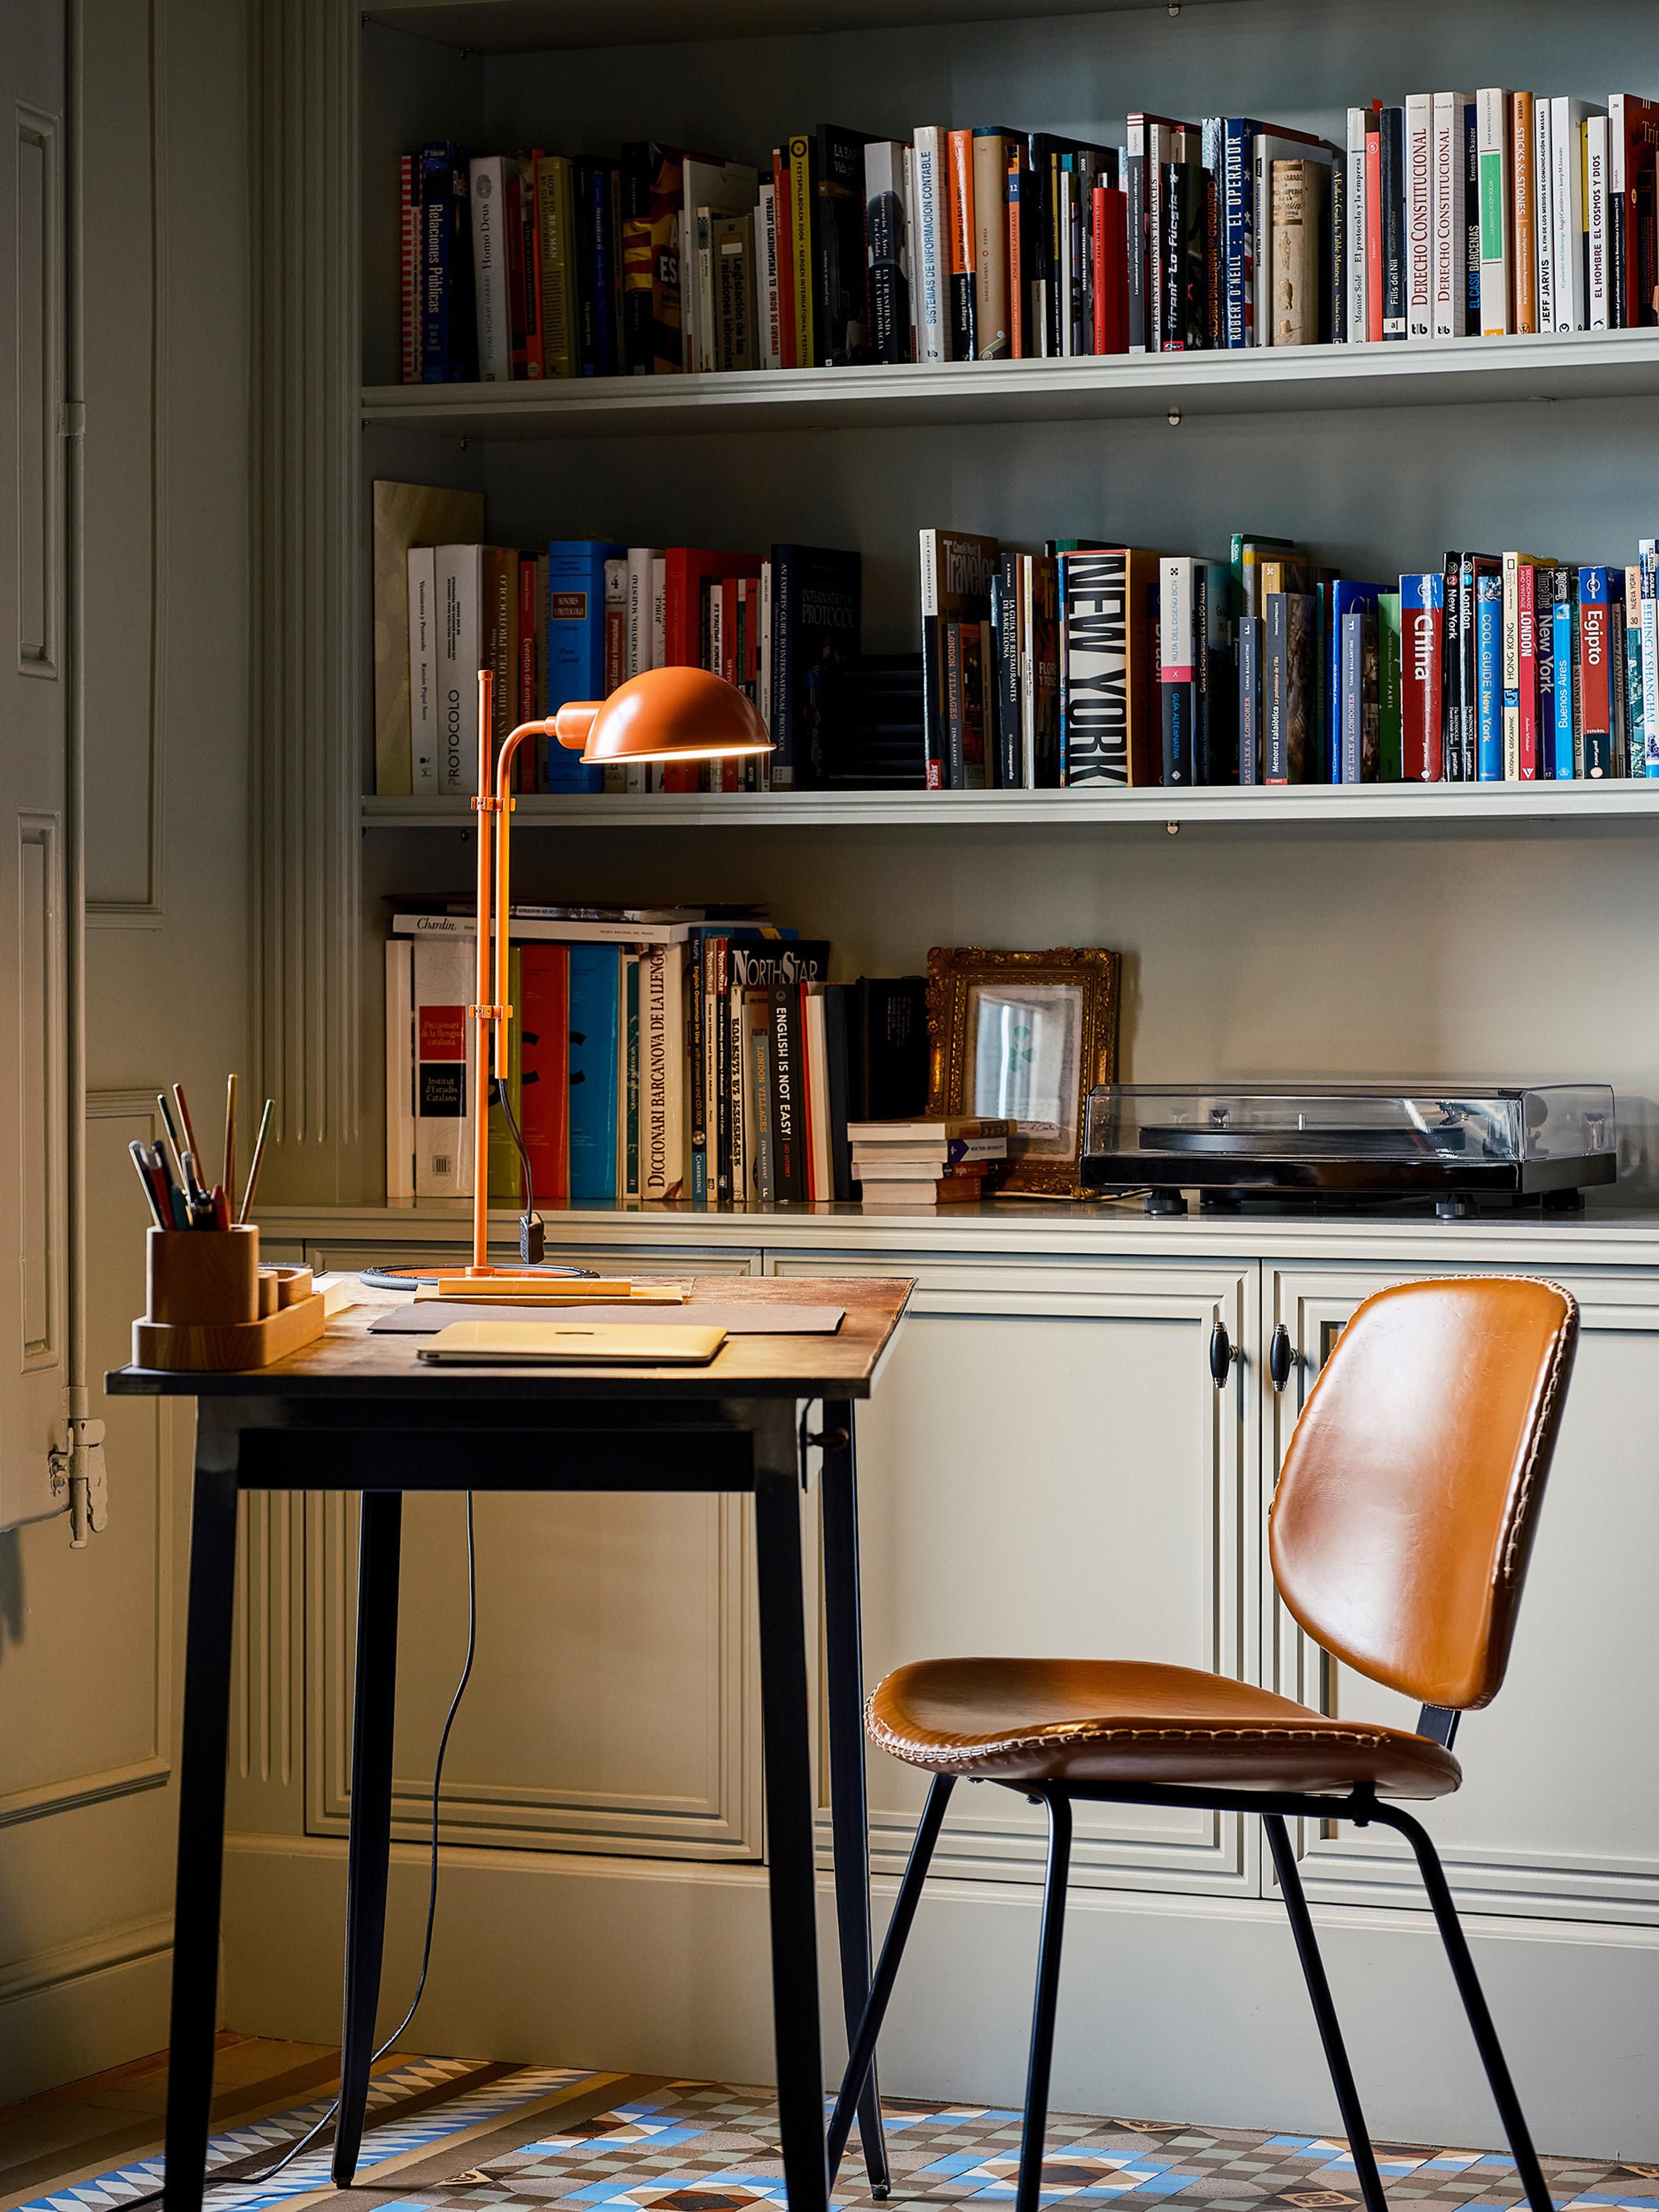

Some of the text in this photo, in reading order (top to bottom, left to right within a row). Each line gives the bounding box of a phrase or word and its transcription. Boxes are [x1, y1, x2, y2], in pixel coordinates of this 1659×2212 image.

[1516, 127, 1525, 161] STICKS
[1517, 163, 1525, 173] &
[1354, 194, 1361, 202] la
[1411, 128, 1427, 306] DERECHO CONSTITUCIONAL
[1437, 128, 1450, 301] DERECHO CONSTITUCIONAL
[1593, 189, 1601, 226] COSMOS
[481, 204, 491, 269] Homo Deus
[766, 196, 776, 286] EL PENSAMIENTO LATERAL
[921, 152, 936, 324] SISTEMAS DE INFORMACION CONTABLE
[1227, 137, 1241, 340] ROBERT O'NEILL EL OPERADOR
[1354, 211, 1363, 250] protocolo
[1594, 228, 1601, 239] EL
[428, 205, 444, 313] Relaciones Públicas
[1355, 253, 1361, 262] El
[1468, 226, 1480, 308] EL CASO BÁRCENAS
[1541, 259, 1550, 296] JARVIS
[1594, 244, 1602, 298] EL HOMBRE
[721, 259, 733, 369] relaciones laborales
[733, 258, 745, 354] Legislación de las
[1390, 287, 1399, 304] Fills
[771, 313, 777, 322] DE
[781, 563, 787, 575] AN
[1003, 600, 1009, 611] DE
[1009, 599, 1015, 609] LA
[780, 637, 786, 649] TO
[1010, 633, 1016, 644] DE
[1414, 615, 1433, 680] China
[1448, 614, 1457, 639] York
[1483, 614, 1491, 648] COOL
[1521, 611, 1532, 656] LONDON
[1584, 610, 1603, 665] Egipto
[947, 630, 957, 719] LONDON VILLAGES
[1068, 556, 1127, 785] NEW YORK
[1483, 651, 1491, 686] GUIDE
[1539, 615, 1553, 693] New York
[1644, 604, 1655, 723] BEIJING Y SHANGHAI
[1558, 660, 1568, 728] Buenos Aires
[448, 690, 460, 786] PROTOCOLO
[1271, 706, 1279, 739] talaiòtica
[1483, 718, 1491, 742] York
[417, 917, 457, 931] Chardin
[651, 997, 664, 1011] LA
[651, 1014, 664, 1030] DE
[437, 1029, 464, 1039] llengua
[650, 1035, 664, 1107] BARCANOVA
[757, 1046, 768, 1132] LONDON VILLAGES
[775, 1008, 791, 1134] ENGLISH IS NOT EASY
[648, 1110, 665, 1187] DICCIONARI
